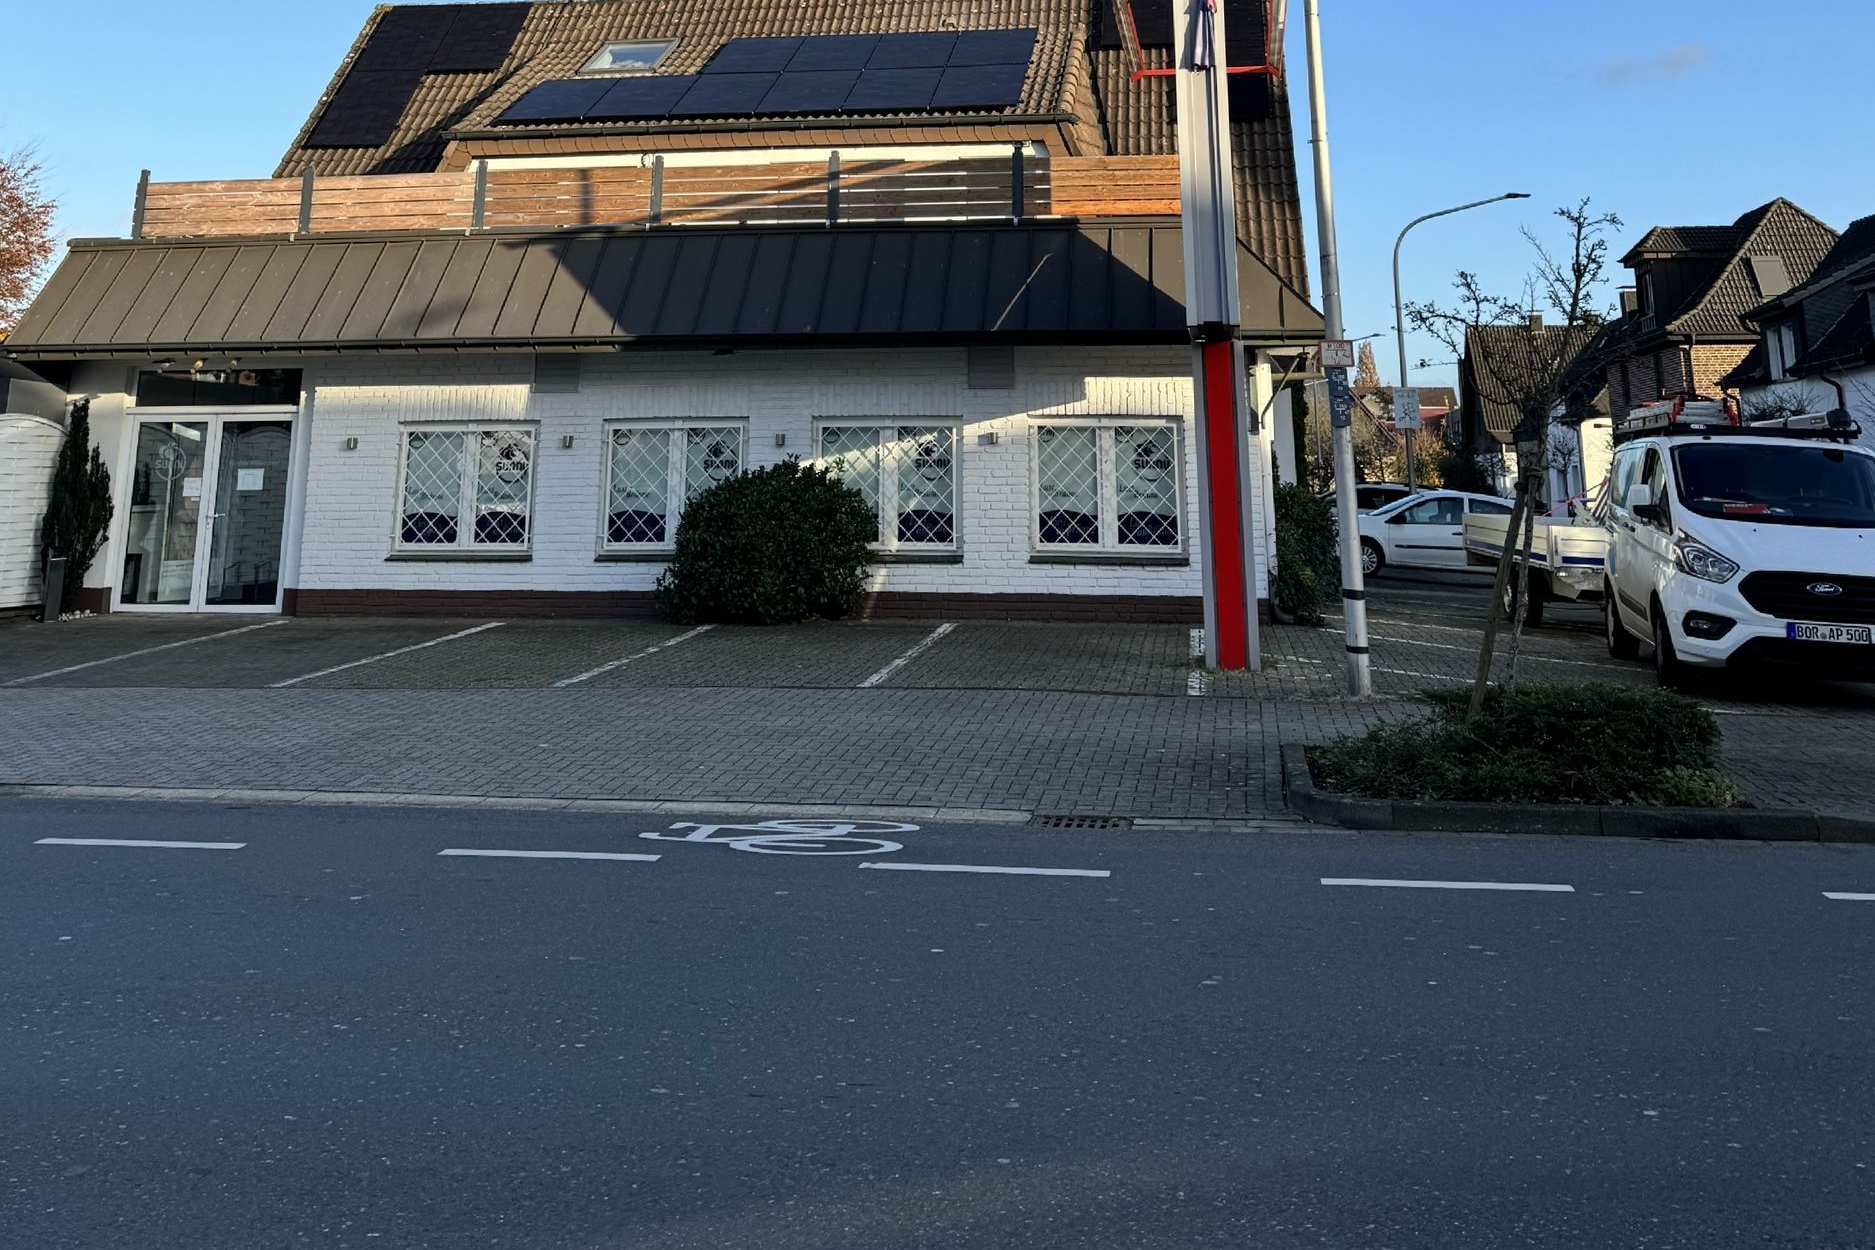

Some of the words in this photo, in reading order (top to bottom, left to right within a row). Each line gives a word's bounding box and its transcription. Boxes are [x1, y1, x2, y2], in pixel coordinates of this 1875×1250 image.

[1815, 584, 1834, 592] Ford
[1796, 625, 1819, 639] BOR
[1828, 627, 1843, 641] AP
[1846, 628, 1868, 642] 500
